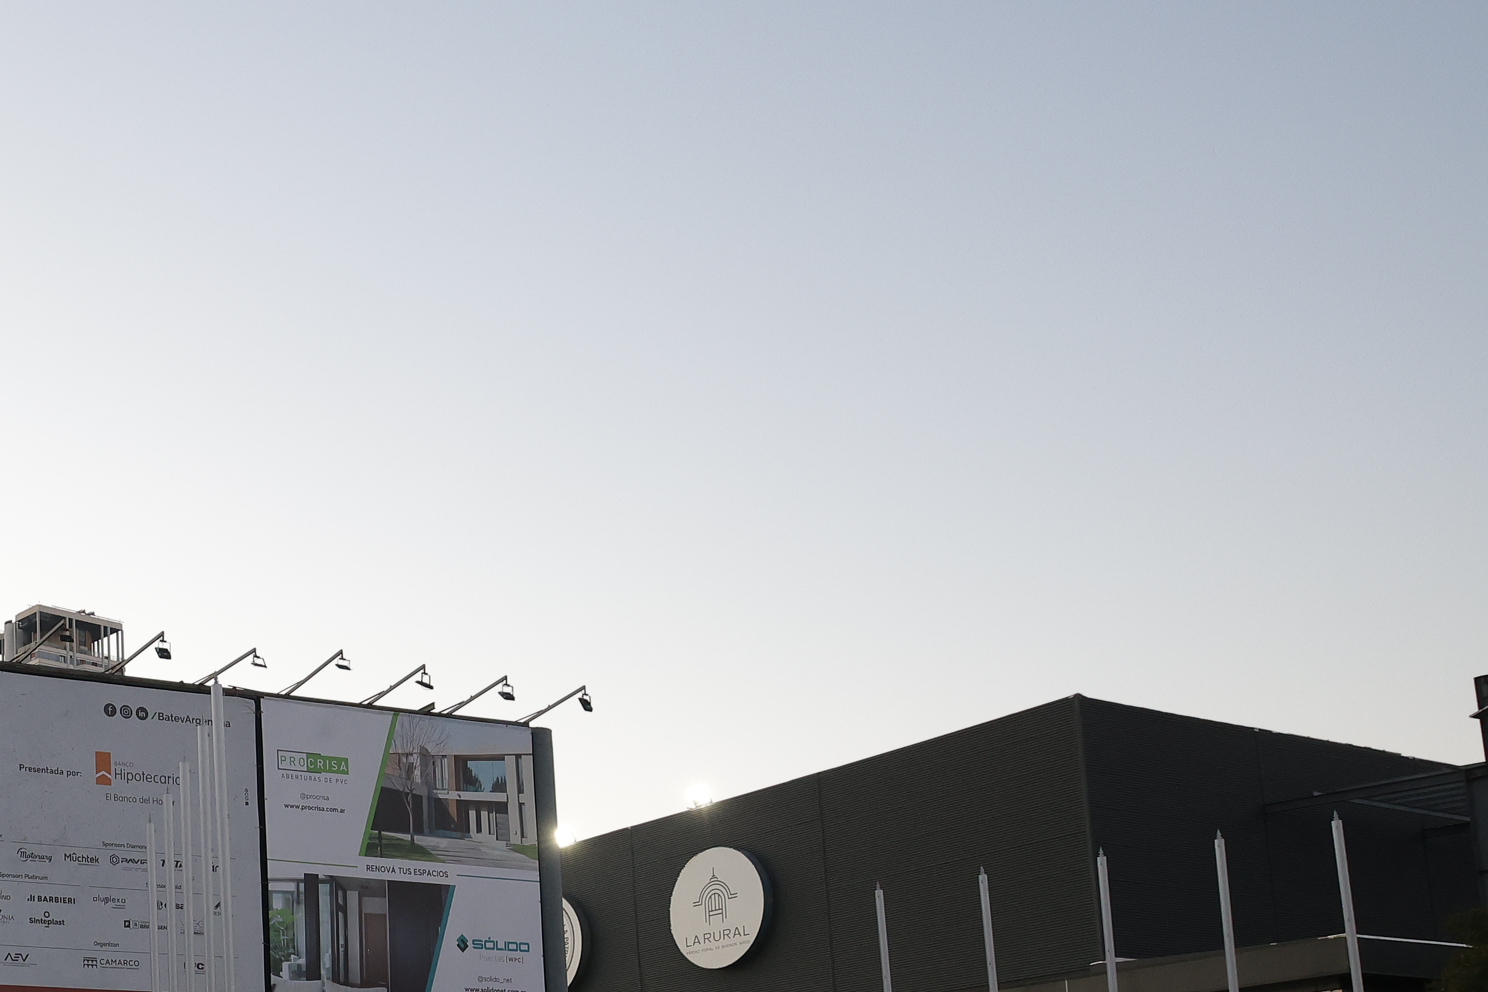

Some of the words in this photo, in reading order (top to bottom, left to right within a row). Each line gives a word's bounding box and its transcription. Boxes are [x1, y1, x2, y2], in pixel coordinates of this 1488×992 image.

[280, 755, 348, 772] PROCRISA
[19, 763, 63, 776] Presentada
[66, 769, 82, 778] por:
[281, 773, 322, 783] ABERTURAS
[105, 793, 112, 801] El
[113, 793, 137, 803] Banco
[139, 796, 150, 805] del
[152, 797, 175, 806] Hor
[299, 792, 330, 801] @procrisa
[283, 803, 346, 813] www.procrisa.com.ar
[126, 842, 147, 850] Diamon
[366, 864, 396, 874] RENOVÁ
[398, 867, 412, 875] TUS
[413, 868, 449, 878] ESPACIOS
[24, 873, 48, 881] Platinum
[37, 894, 76, 905] BARBIERI
[29, 917, 65, 927] Sinteplast
[93, 940, 120, 948] Organizan
[472, 937, 530, 953] SÓLIDO
[99, 957, 140, 968] CAMARCO
